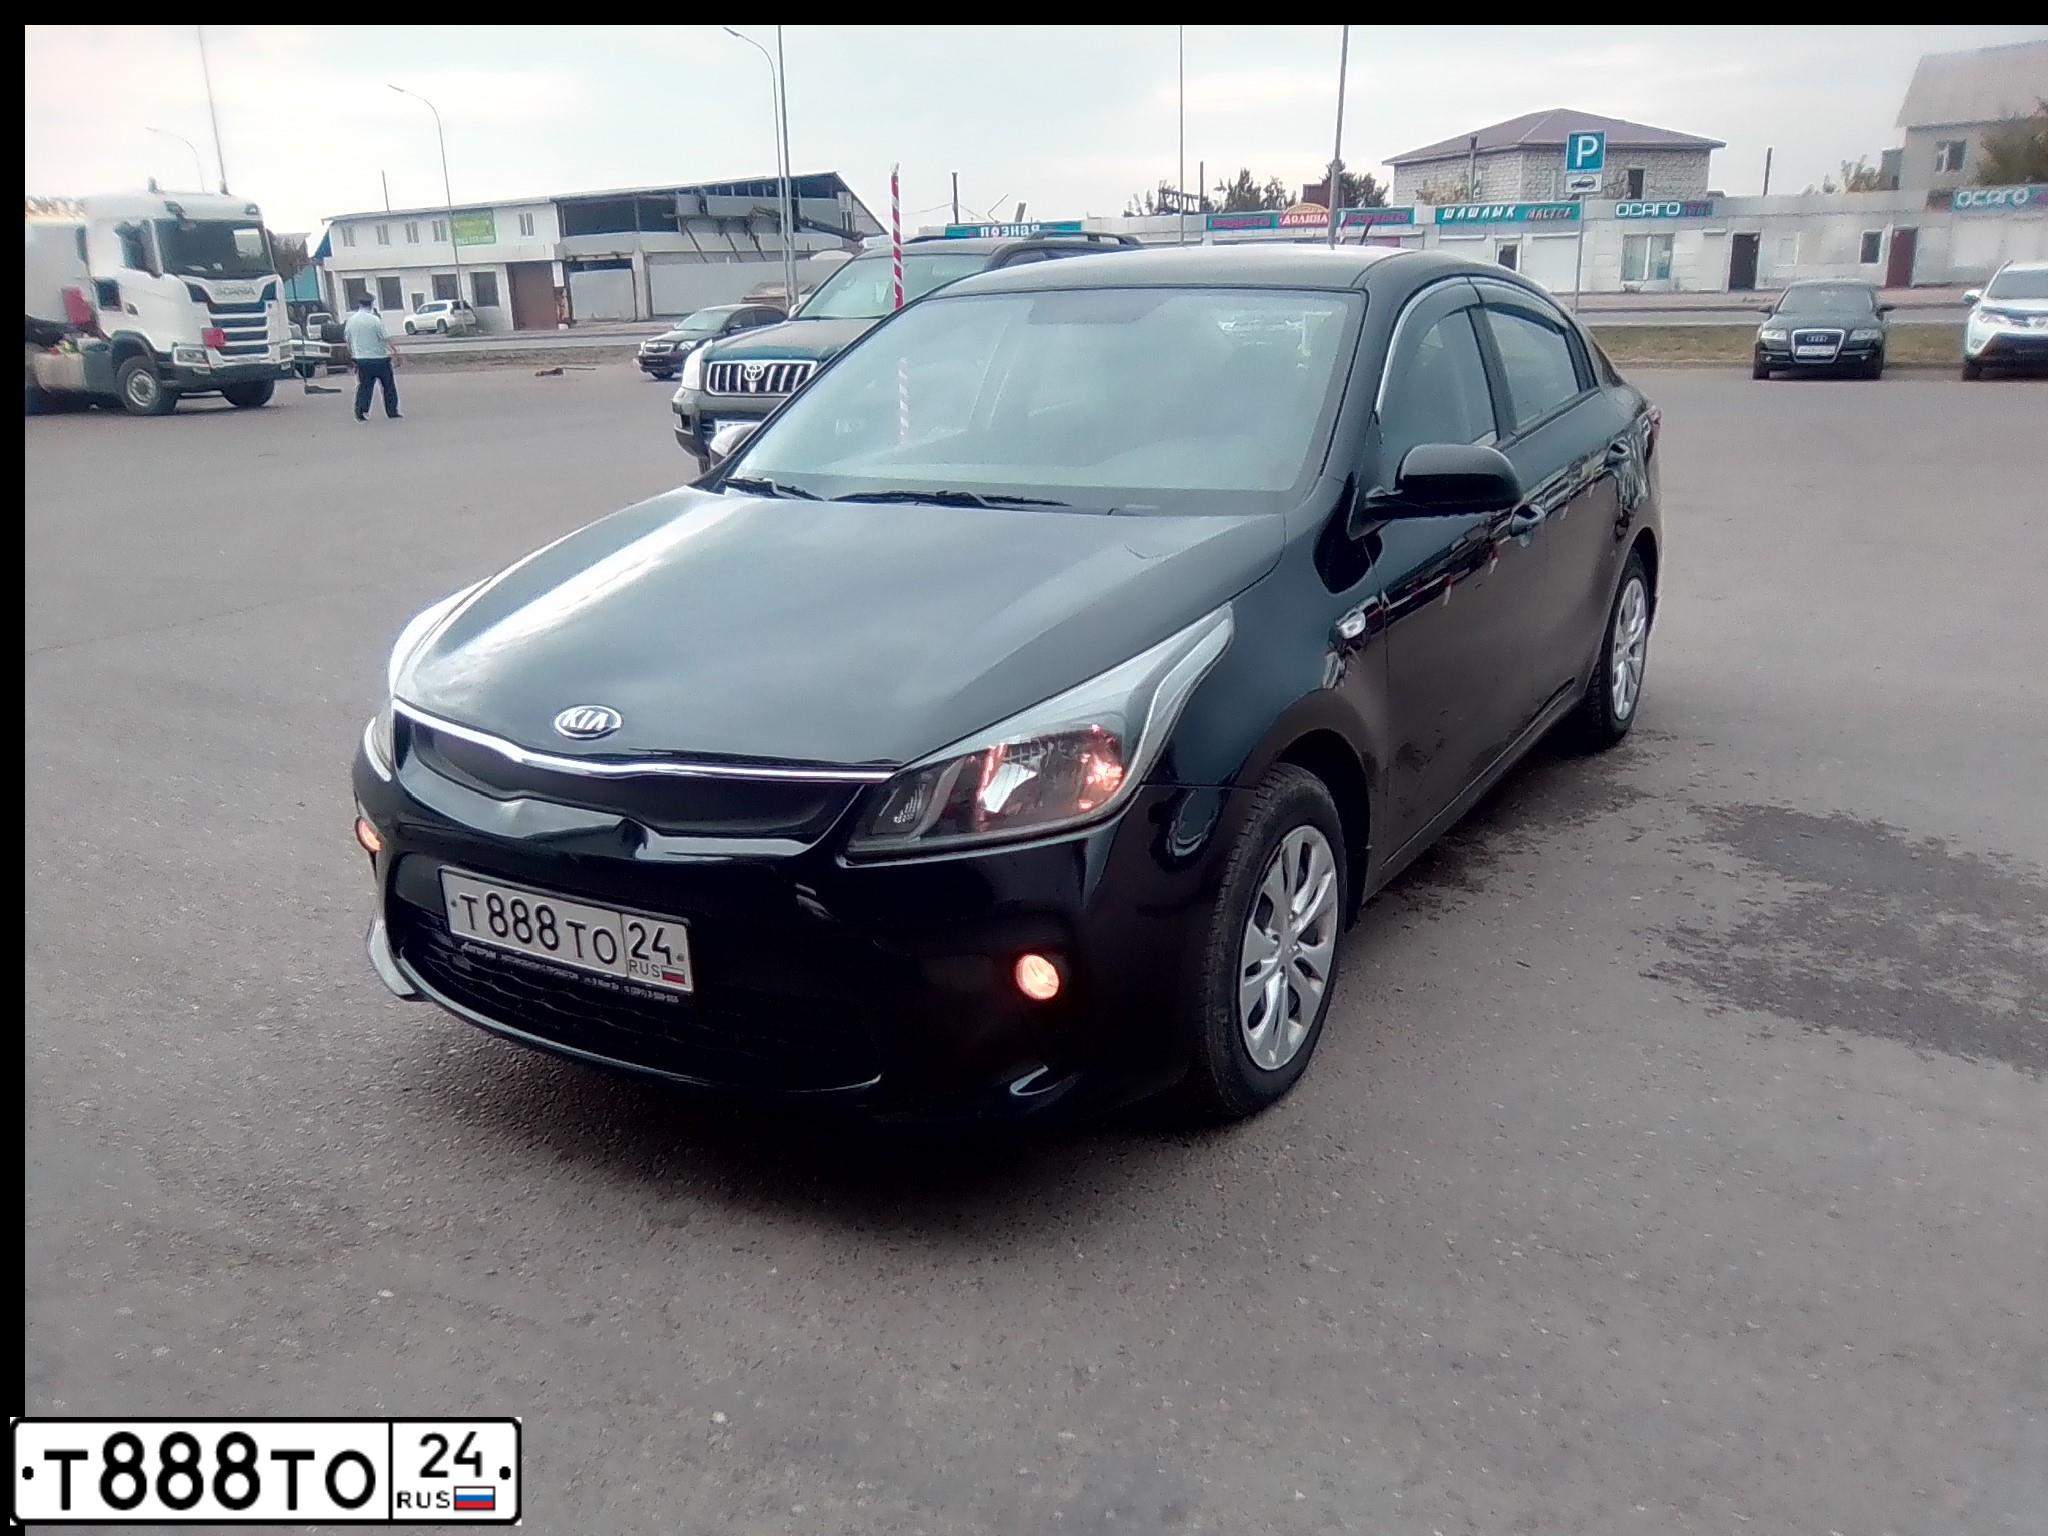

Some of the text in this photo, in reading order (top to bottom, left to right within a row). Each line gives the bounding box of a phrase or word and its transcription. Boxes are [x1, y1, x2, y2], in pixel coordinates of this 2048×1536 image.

[1576, 135, 1599, 168] P
[1442, 205, 1517, 220] ШАШЛЫК
[1615, 201, 1680, 216] ОСАГО
[560, 708, 611, 732] KIA
[628, 921, 673, 966] 24
[628, 958, 662, 978] RUS
